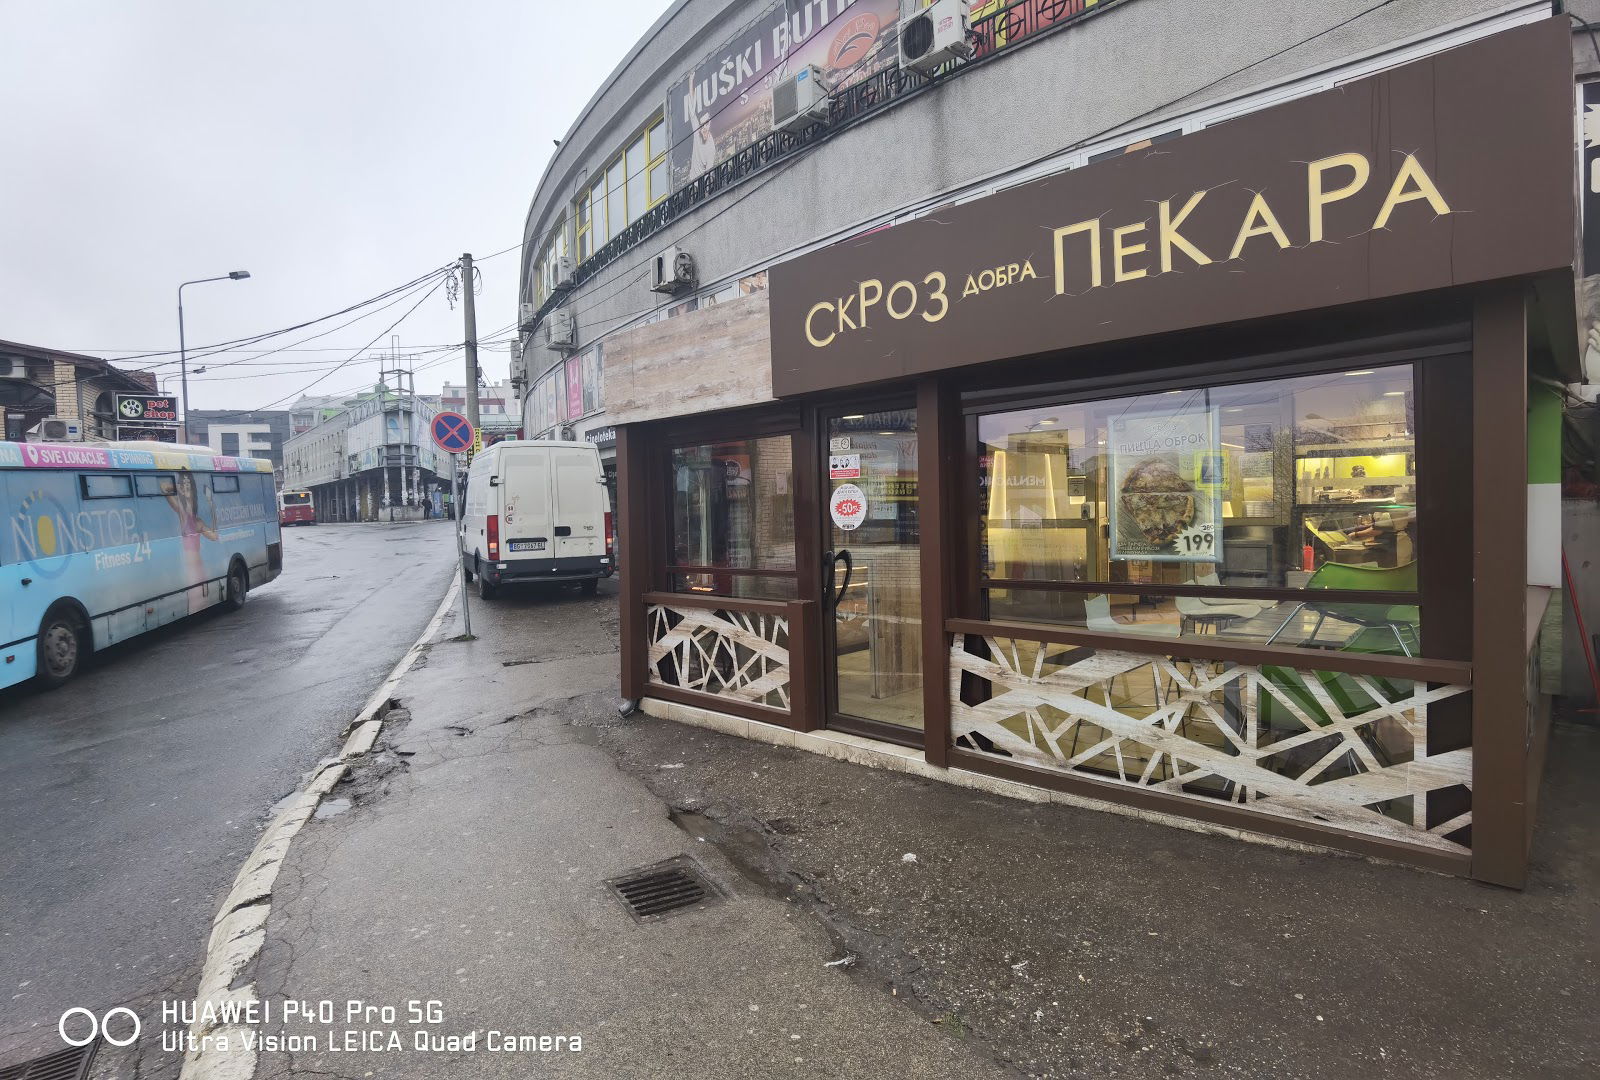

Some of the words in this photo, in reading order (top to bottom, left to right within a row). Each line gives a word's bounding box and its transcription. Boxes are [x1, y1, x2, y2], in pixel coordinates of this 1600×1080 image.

[683, 39, 762, 124] MUŠKI
[772, 0, 857, 60] BUTI
[805, 270, 950, 348] СКРОЗ
[962, 262, 1038, 298] ДОБРА
[1053, 152, 1452, 296] ПЕКАРА
[144, 410, 175, 420] shop
[147, 400, 169, 410] pet
[1120, 439, 1161, 455] ПИЦЦА
[1164, 433, 1206, 447] ОБРОК
[41, 449, 61, 463] SVE
[63, 451, 106, 466] LOKACIJE
[10, 508, 137, 562] NONSTOP
[1183, 533, 1214, 552] 199
[94, 552, 132, 572] Fitness
[131, 532, 152, 563] 24
